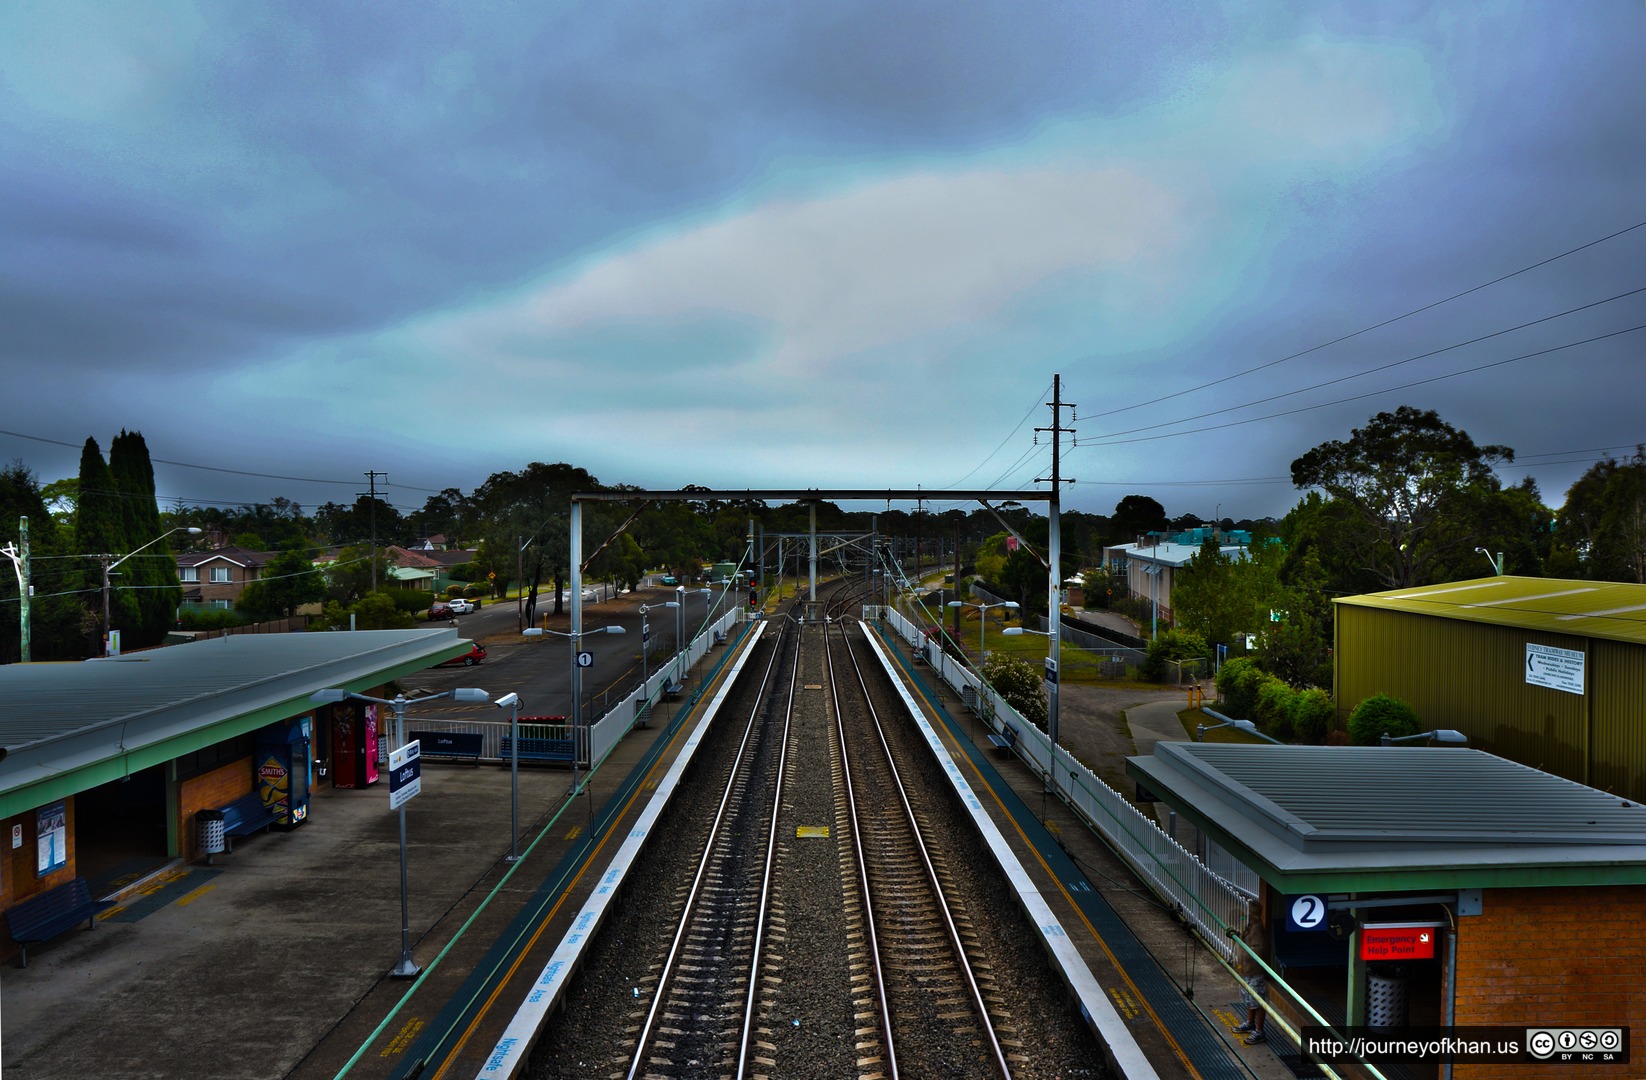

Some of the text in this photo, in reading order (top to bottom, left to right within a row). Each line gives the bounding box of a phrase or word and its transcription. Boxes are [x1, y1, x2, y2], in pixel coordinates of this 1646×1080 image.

[582, 655, 587, 664] 1
[399, 767, 414, 783] Loftus
[1300, 897, 1317, 923] 2
[1367, 935, 1417, 945] Emergency
[1367, 945, 1415, 955] Help Point
[529, 989, 547, 1002] Area
[486, 1038, 518, 1071] Nightsafe
